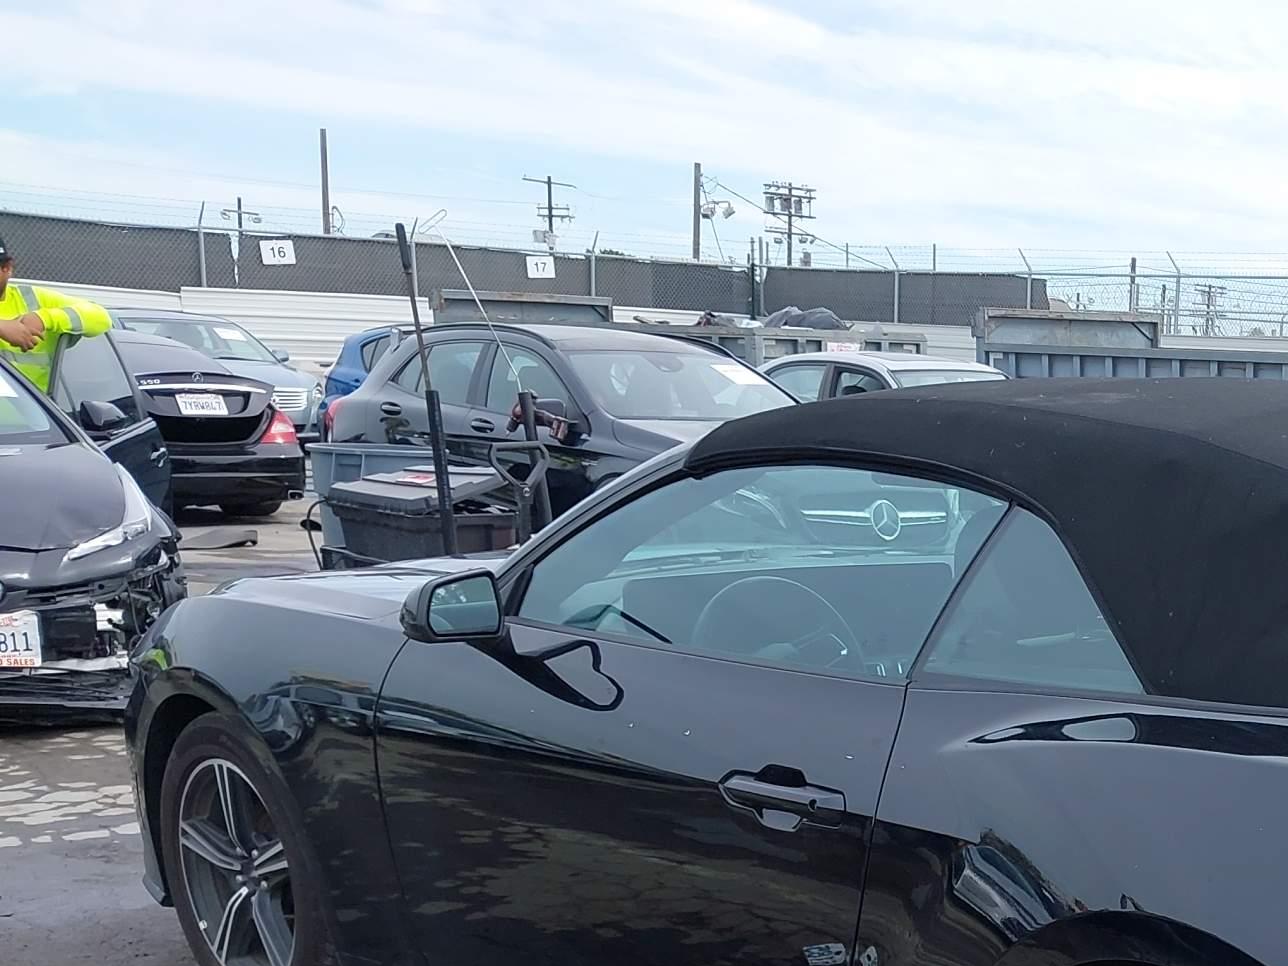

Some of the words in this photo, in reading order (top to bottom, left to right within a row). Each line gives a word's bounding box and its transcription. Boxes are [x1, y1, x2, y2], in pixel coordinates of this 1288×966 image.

[270, 246, 286, 258] 16
[533, 261, 547, 272] 17
[6, 658, 35, 666] SALES
